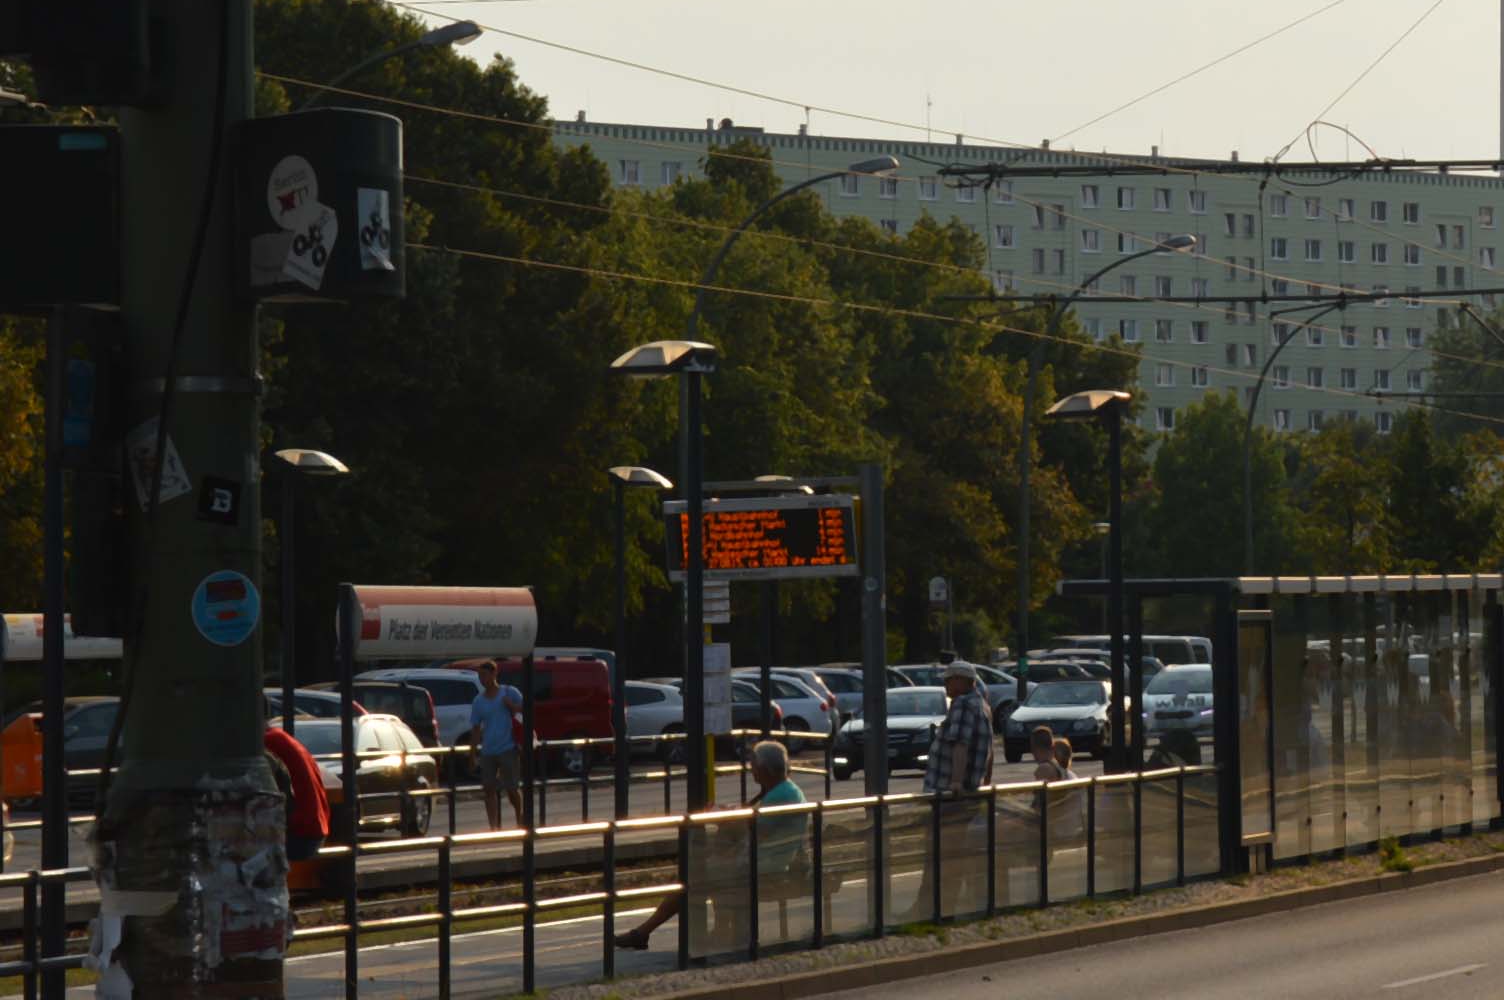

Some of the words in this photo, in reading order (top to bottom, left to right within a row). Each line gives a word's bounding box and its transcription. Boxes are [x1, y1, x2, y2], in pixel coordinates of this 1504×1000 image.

[389, 618, 412, 642] Platz
[413, 618, 429, 641] der
[474, 618, 513, 642] Nationen
